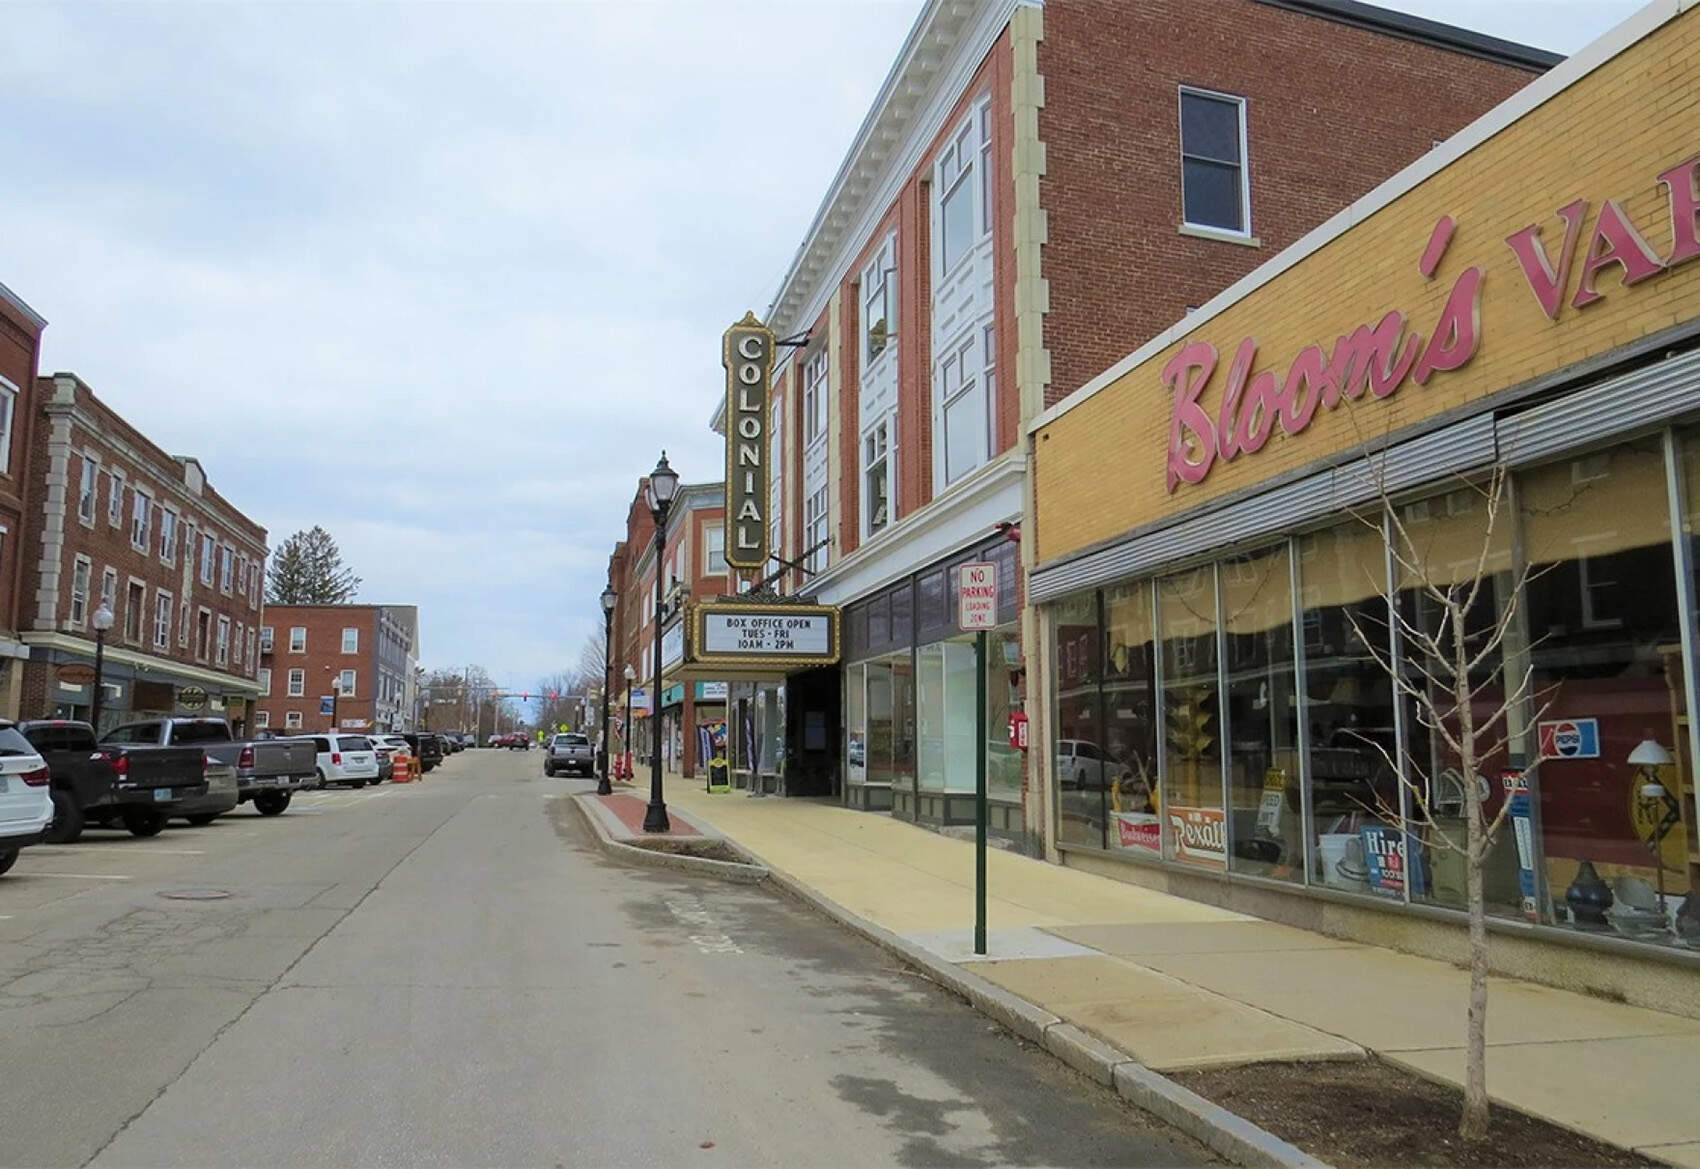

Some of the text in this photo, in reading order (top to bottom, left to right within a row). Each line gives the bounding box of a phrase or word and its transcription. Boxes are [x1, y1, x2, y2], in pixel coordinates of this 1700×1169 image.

[1161, 214, 1485, 494] Bloom's
[736, 334, 764, 550] COLONIAL
[971, 570, 985, 582] NO
[961, 585, 994, 598] PARKING
[727, 618, 811, 628] BOX OFFICE OPEN
[742, 630, 765, 638] TUES
[773, 629, 789, 638] FRI
[738, 639, 763, 649] 10AM
[775, 640, 794, 649] 2PM
[1555, 734, 1580, 745] PEPSI
